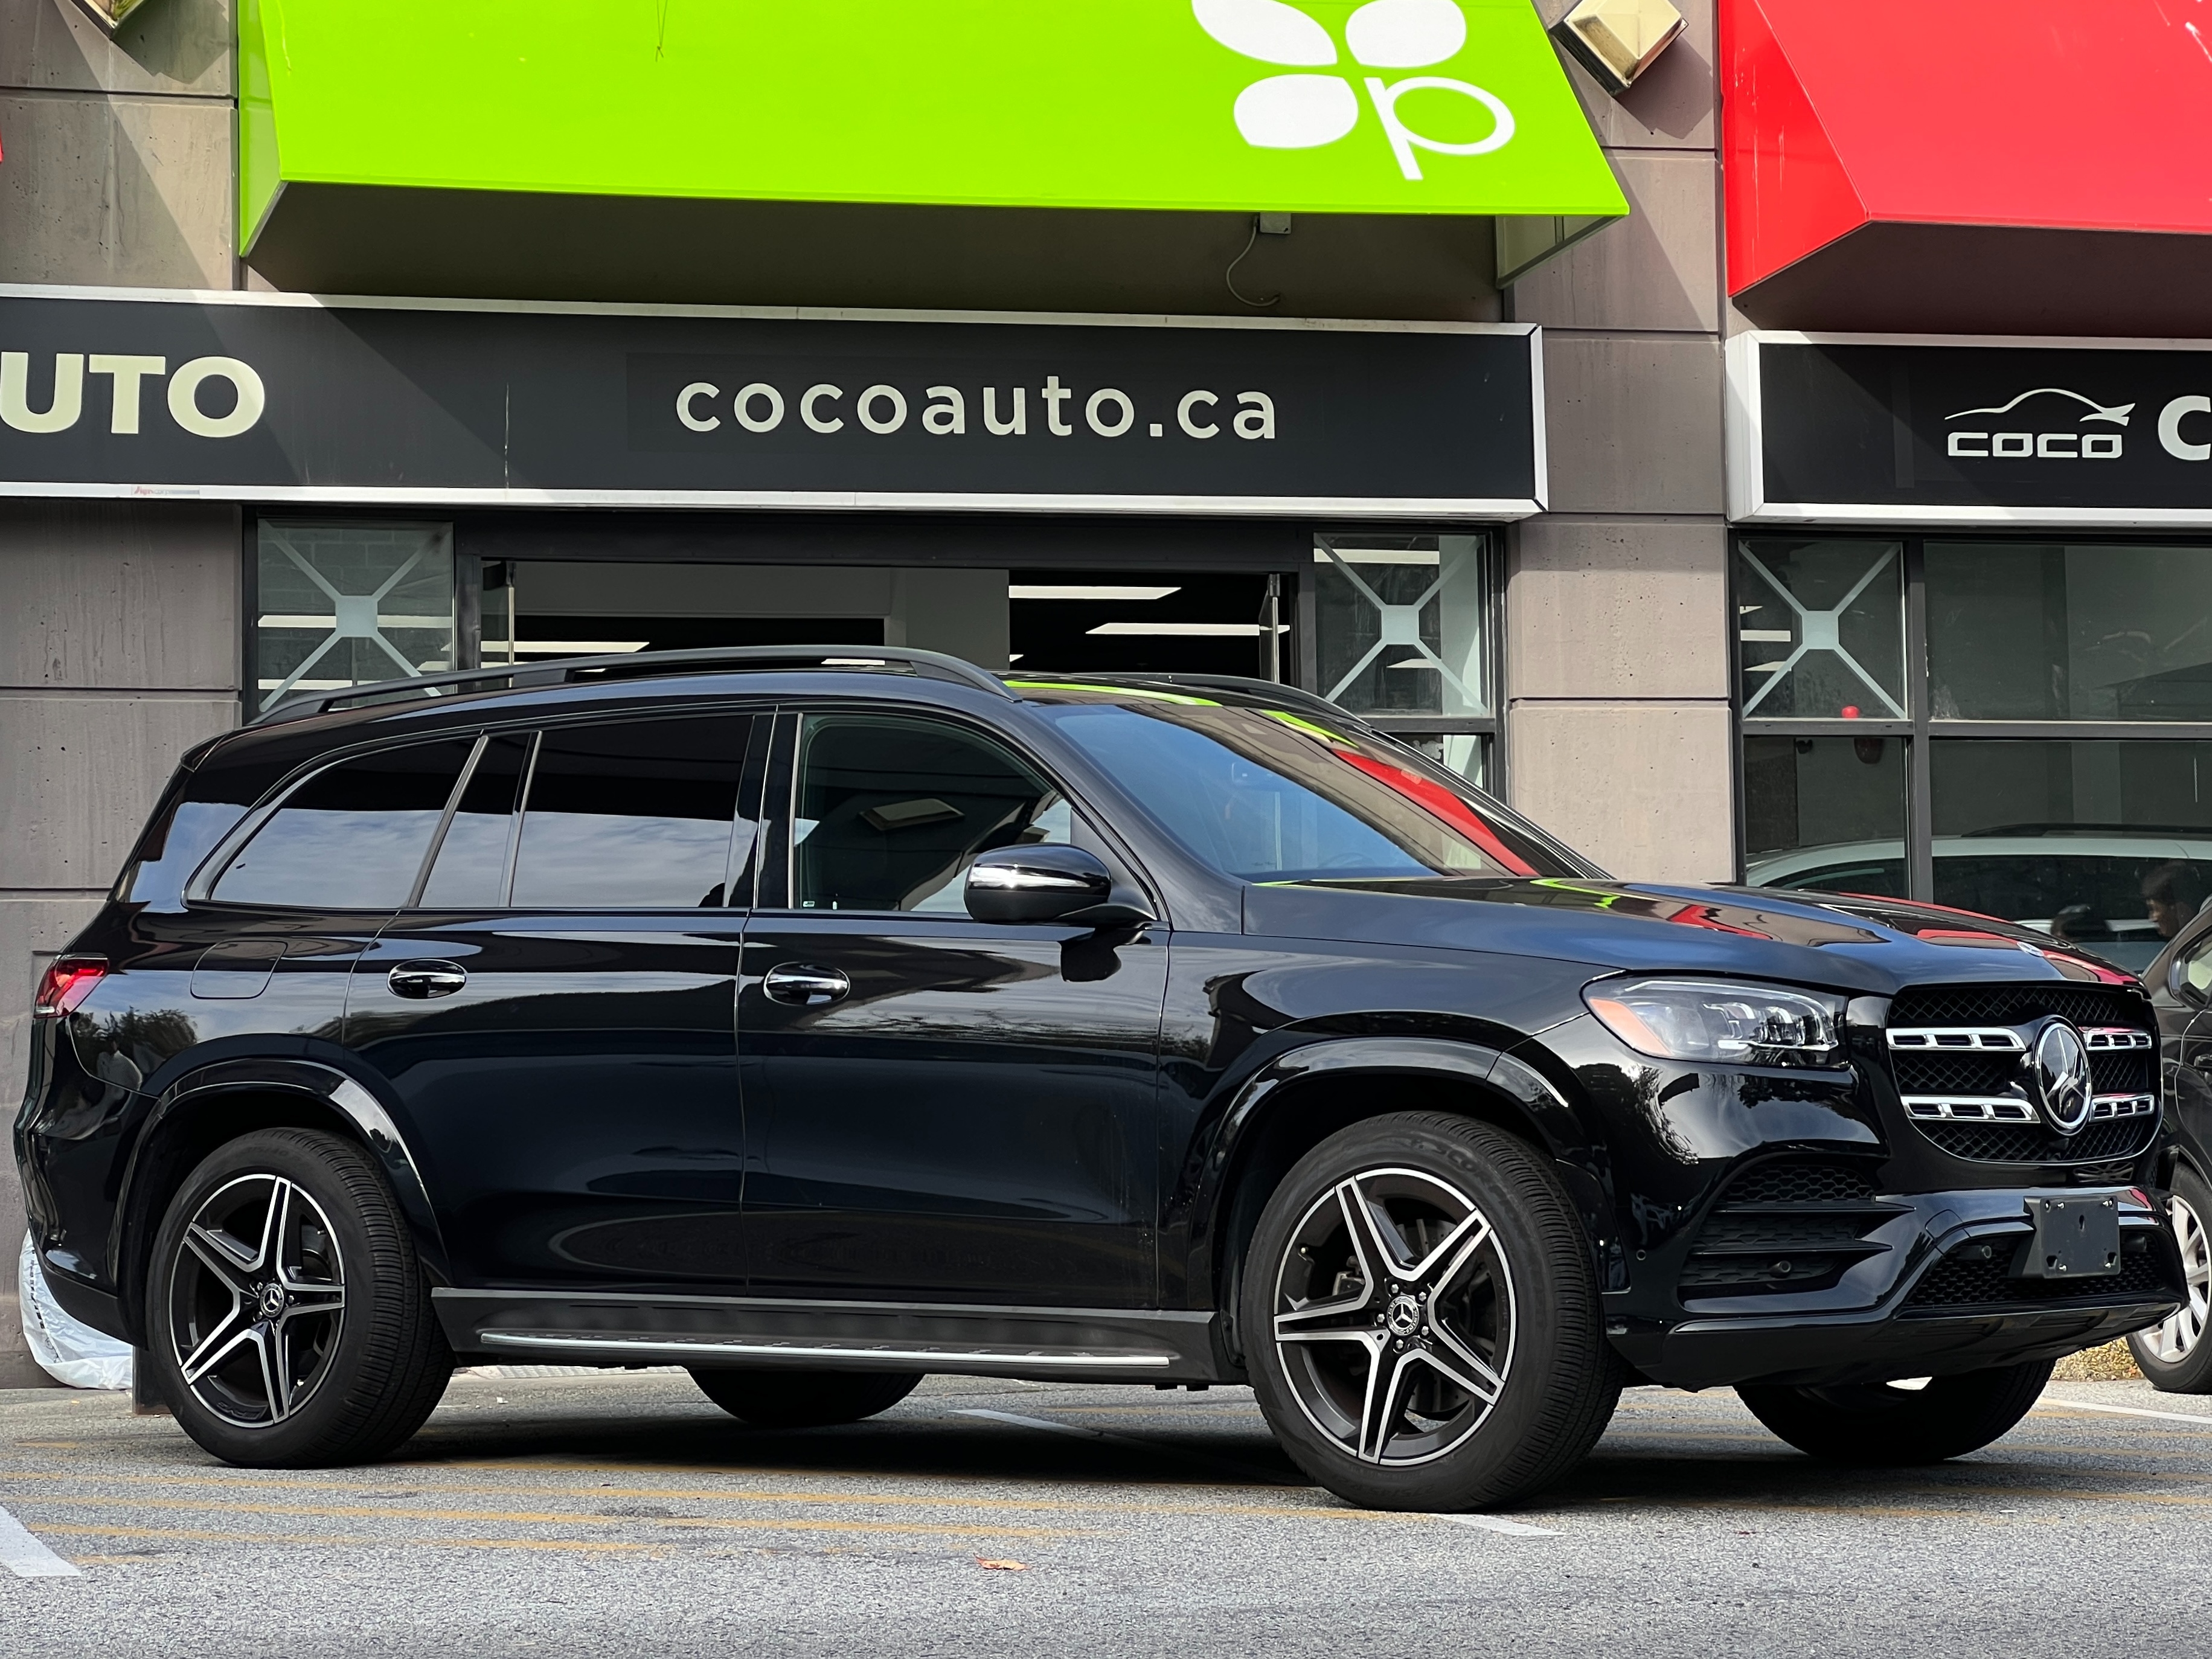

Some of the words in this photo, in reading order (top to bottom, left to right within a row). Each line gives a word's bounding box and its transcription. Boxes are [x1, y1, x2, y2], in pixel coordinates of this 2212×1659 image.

[0, 351, 266, 438] UTO
[676, 376, 1276, 440] cocoauto.ca
[1948, 432, 2123, 459] COCO
